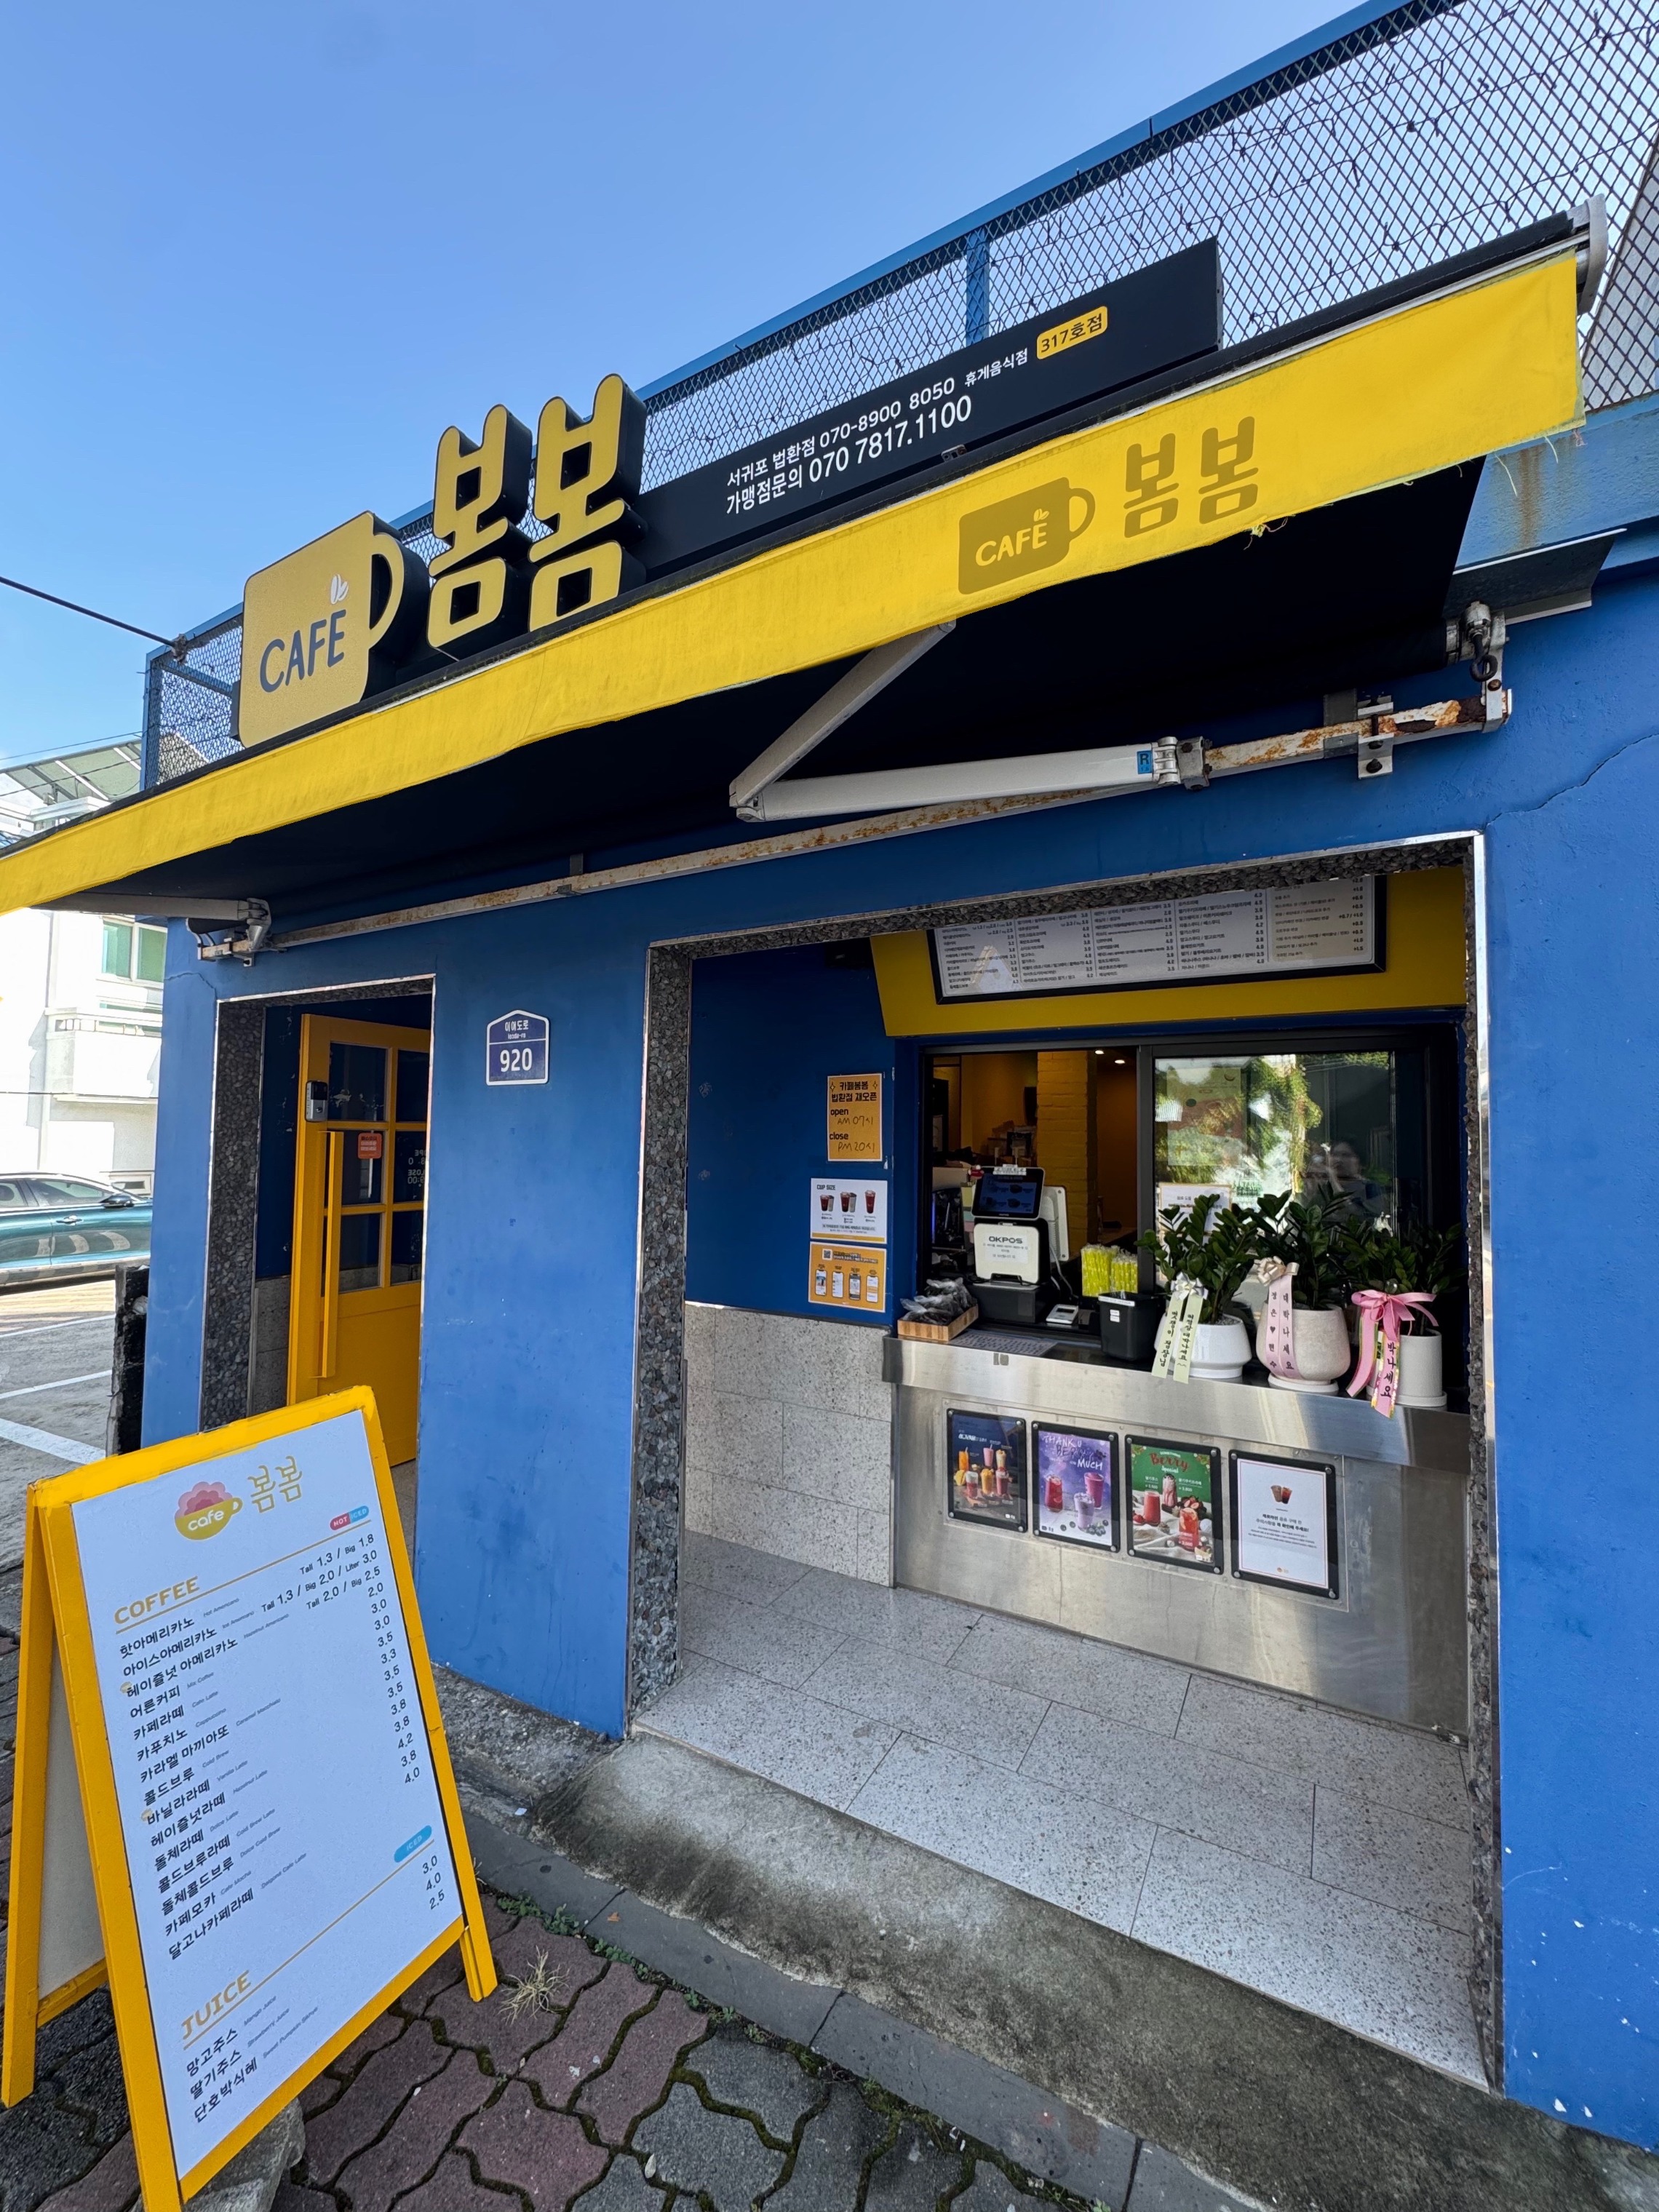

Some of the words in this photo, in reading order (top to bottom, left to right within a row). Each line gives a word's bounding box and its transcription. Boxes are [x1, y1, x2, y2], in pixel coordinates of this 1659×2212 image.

[1041, 313, 1102, 353] 317호점
[727, 458, 768, 488] 서귀포
[773, 436, 816, 472] 법환점
[820, 401, 902, 448] 070-8900
[909, 378, 955, 410] 8050
[965, 348, 1028, 387] 휴게음식점
[727, 465, 803, 515] 가맹점문의
[809, 446, 849, 482] 070
[855, 395, 972, 464] 7817.1100
[1123, 416, 1259, 538] 봄봄
[426, 373, 627, 648] 봄봄
[1139, 753, 1150, 765] R
[500, 1048, 533, 1073] 920
[832, 1093, 853, 1102] 법환점
[855, 1092, 878, 1102] 재오픈
[840, 1081, 869, 1091] 카페봄봄
[830, 1108, 848, 1117] open
[830, 1132, 848, 1140] close
[838, 1142, 852, 1152] PM
[988, 1236, 1023, 1245] OKPOS
[1077, 1458, 1103, 1471] MUCH
[248, 1455, 303, 1513] 봄봄
[187, 1509, 225, 1531] cafe
[333, 1516, 349, 1527] HOT
[351, 1508, 367, 1519] ICED
[300, 1563, 314, 1575] Tall
[317, 1553, 333, 1567] 1.3
[345, 1545, 356, 1555] Big
[359, 1534, 375, 1548] 1.8
[261, 1601, 275, 1612] Tall
[277, 1590, 293, 1604] 1.3
[306, 1582, 317, 1592] Big
[319, 1570, 335, 1585] 2.0
[346, 1561, 360, 1572] Liter
[362, 1549, 378, 1564] 3.0
[306, 1598, 320, 1610] Tall
[323, 1586, 340, 1602] 2.0
[351, 1578, 362, 1588] Big
[365, 1566, 381, 1581] 2.5
[367, 1582, 383, 1597] 2.0
[114, 1575, 201, 1625] COFFEE
[371, 1599, 387, 1614] 3.0
[120, 1618, 195, 1659] 핫아메리카노
[374, 1615, 390, 1631] 3.0
[377, 1631, 394, 1647] 3.5
[123, 1628, 218, 1677] 아이스아메리카노
[127, 1666, 178, 1698] 헤이즐넛
[180, 1638, 239, 1671] 아메리카노
[381, 1648, 397, 1664] 3.3
[384, 1665, 400, 1681] 3.5
[130, 1685, 181, 1718] 어른커피
[387, 1682, 404, 1698] 3.5
[391, 1698, 407, 1715] 3.8
[133, 1705, 185, 1740] 카페라떼
[394, 1715, 410, 1732] 3.8
[137, 1728, 188, 1762] 카푸치노
[140, 1754, 179, 1783] 카라멜
[181, 1724, 230, 1759] 마끼아또
[398, 1732, 414, 1749] 4.2
[401, 1750, 417, 1767] 3.8
[405, 1767, 421, 1783] 4.0
[143, 1767, 195, 1807] 콜드브루
[147, 1779, 210, 1825] 바닐라라떼
[151, 1791, 226, 1847] 헤이즐넛라떼
[154, 1829, 204, 1872] 돌체라떼
[406, 1835, 423, 1851] ICED
[158, 1834, 231, 1894] 콜드브루라떼
[422, 1855, 438, 1874] 3.0
[162, 1856, 234, 1916] 돌체콜드브루
[426, 1872, 441, 1891] 4.0
[165, 1892, 216, 1937] 카페모카
[429, 1889, 445, 1910] 2.5
[169, 1887, 254, 1960] 달고나카페라떼
[181, 1970, 251, 2040] JUICE
[186, 2028, 239, 2077] 망고주스
[190, 2050, 242, 2100] 딸기주스
[194, 2057, 258, 2123] 단호박식혜
